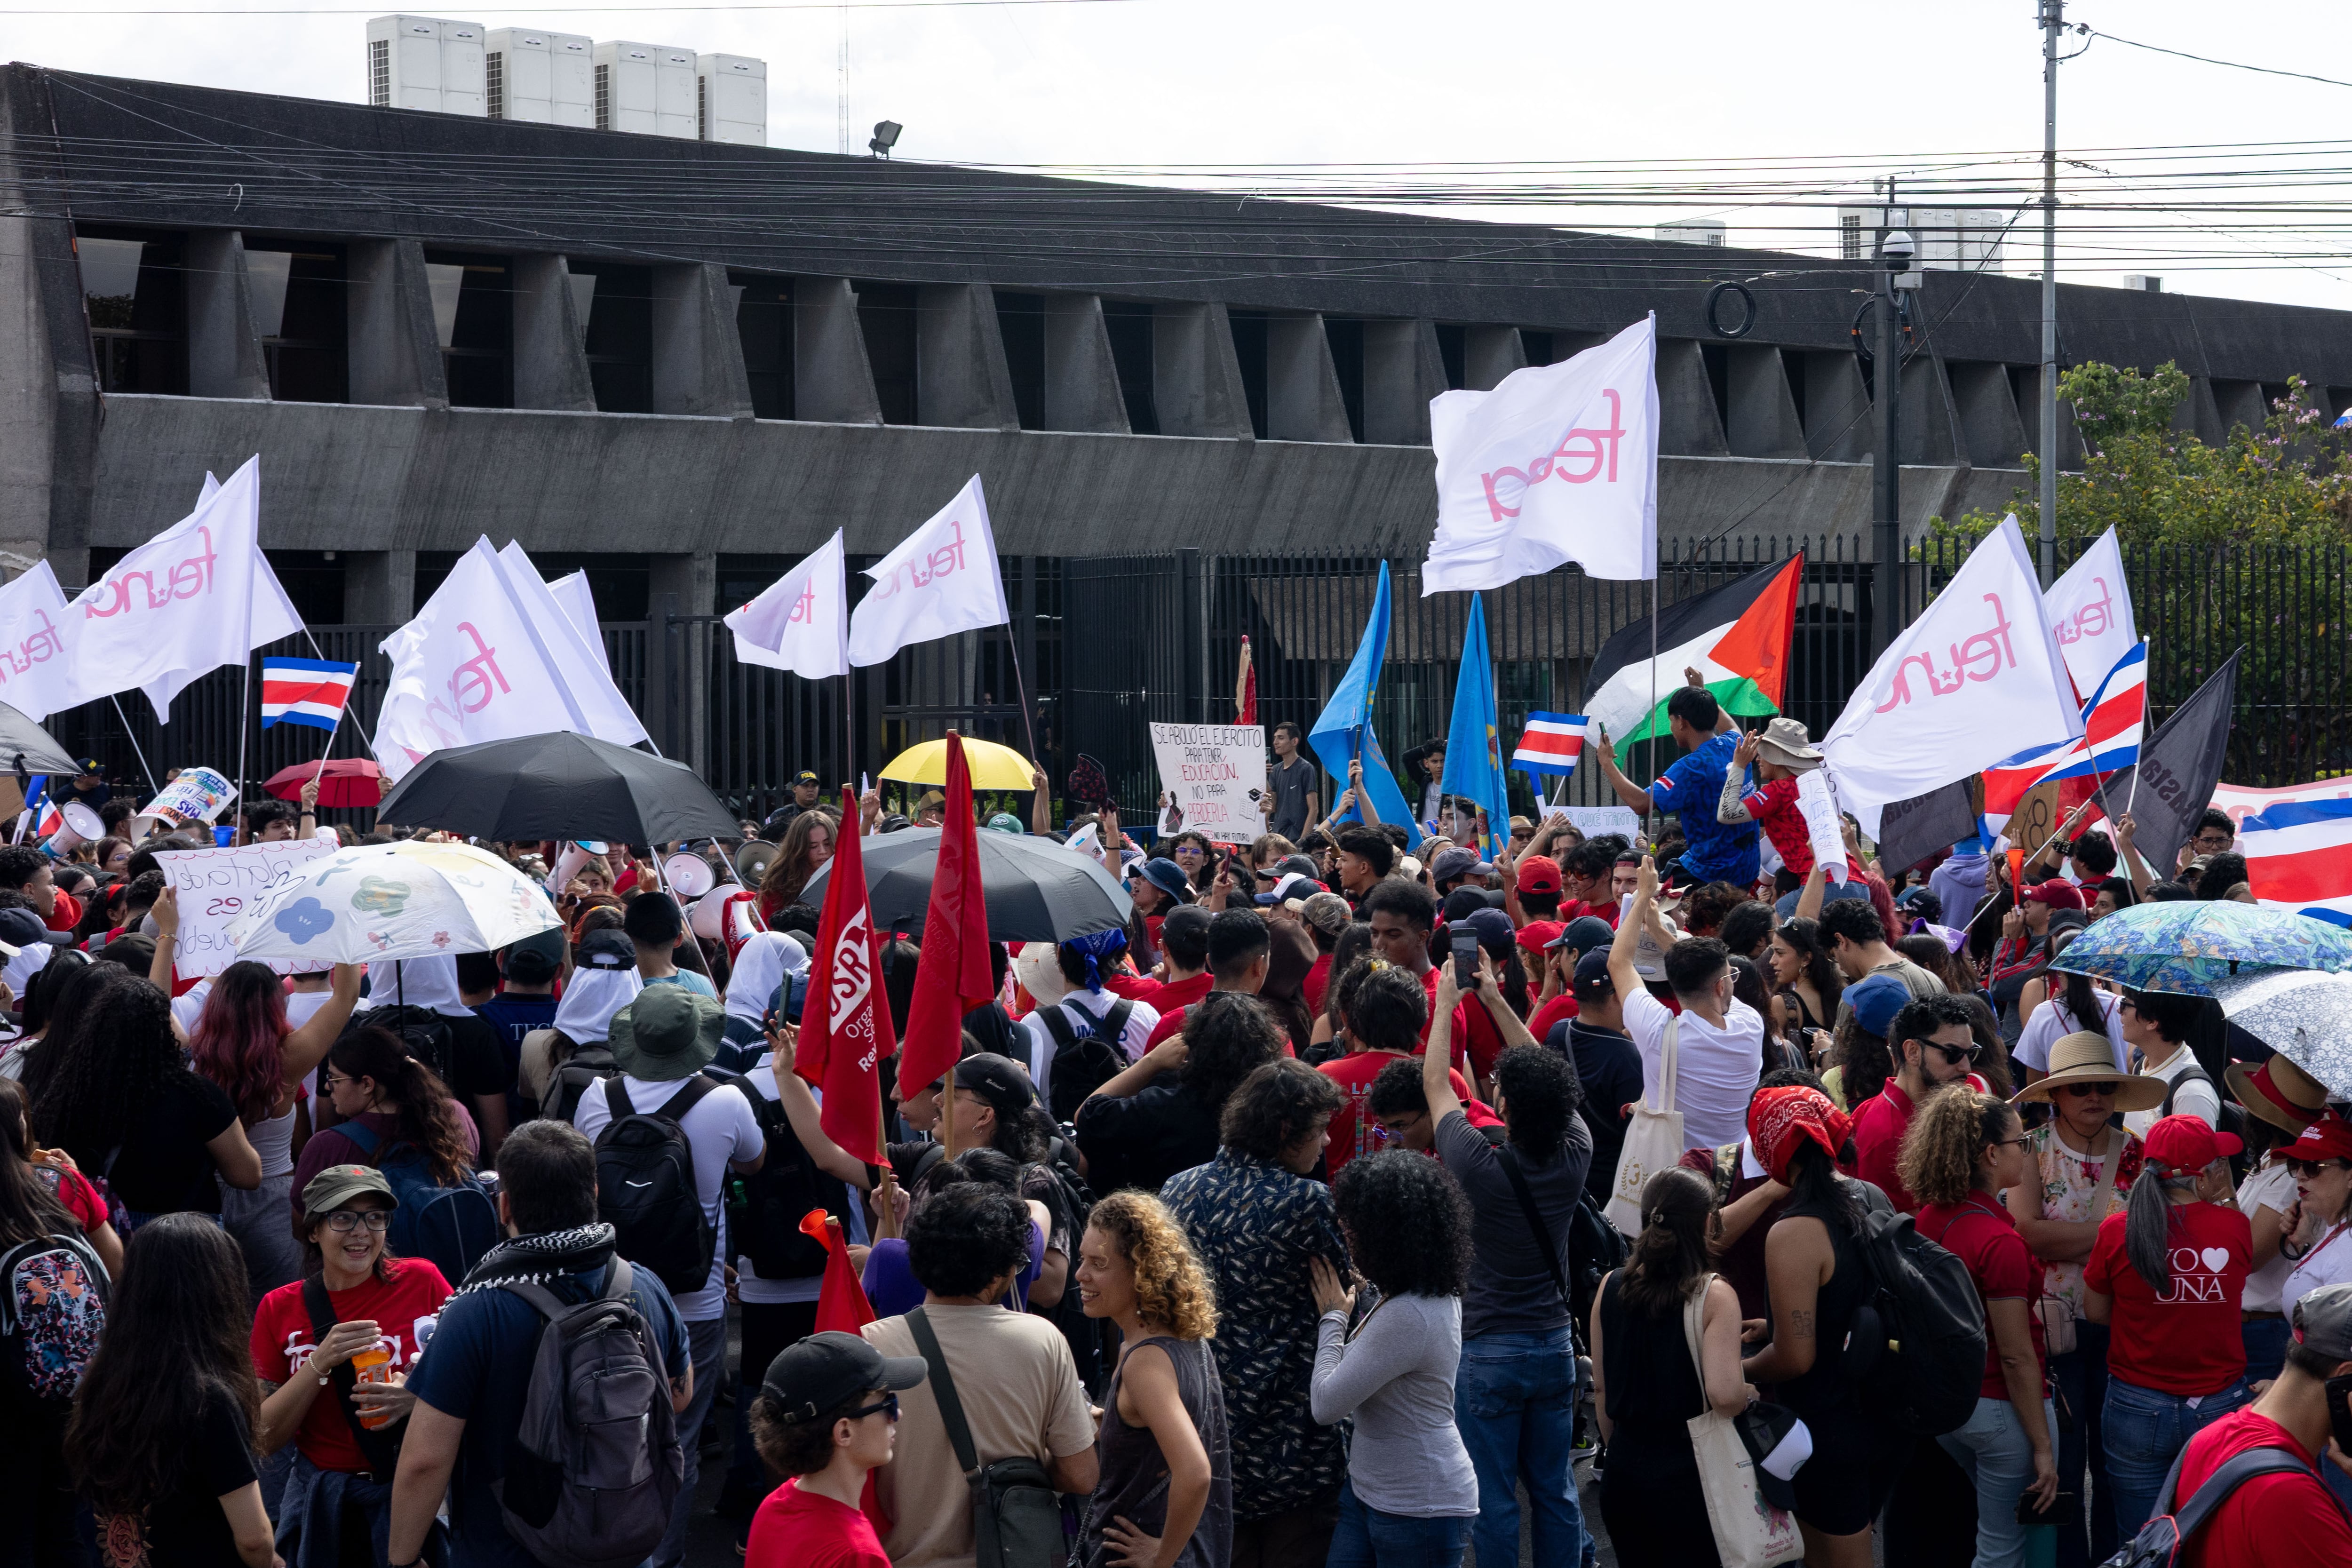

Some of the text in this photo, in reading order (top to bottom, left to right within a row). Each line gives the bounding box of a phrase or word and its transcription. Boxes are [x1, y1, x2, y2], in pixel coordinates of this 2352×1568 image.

[1154, 724, 1168, 744] SE
[1199, 727, 1212, 745] EL
[1213, 724, 1262, 748] EJÉRCITO
[1192, 784, 1227, 800] NO PARA
[164, 807, 188, 824] ENOS
[1187, 803, 1230, 823] PERDERLA
[1577, 808, 1600, 827] QUÉ
[1603, 811, 1638, 826] TANTO
[1639, 939, 1657, 949] UCR
[845, 999, 874, 1039] Orga
[2156, 1277, 2226, 1302] UNA
[283, 1330, 403, 1375] fea
